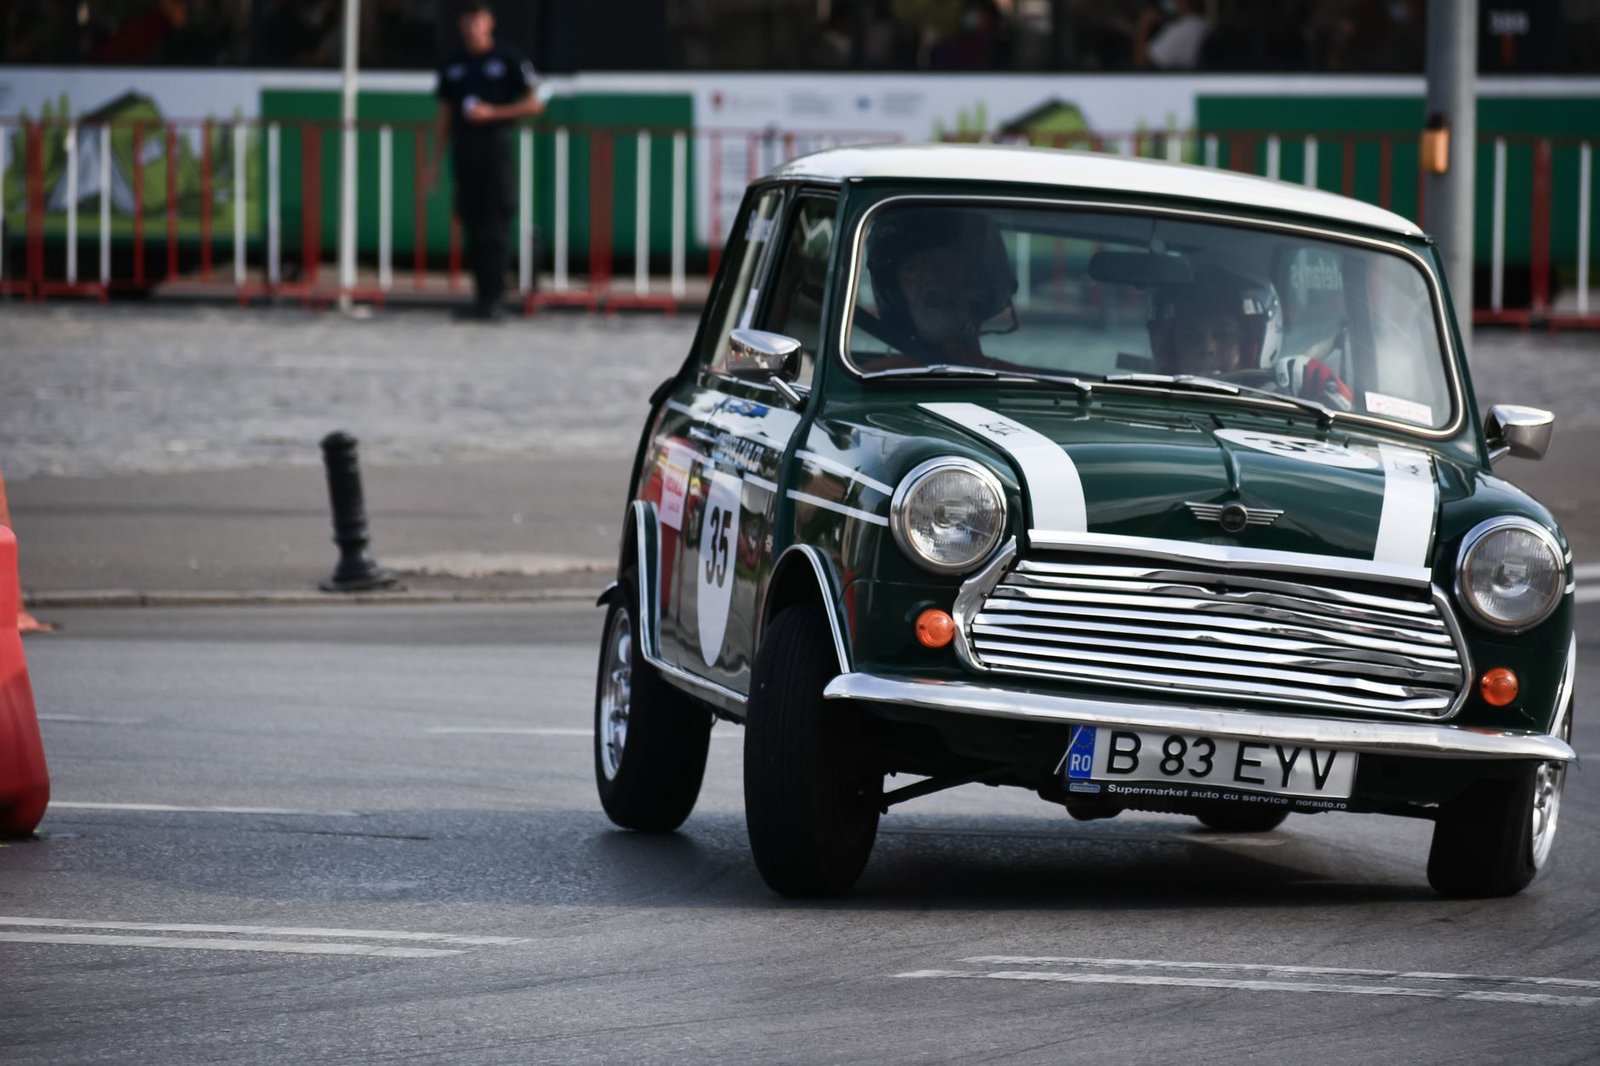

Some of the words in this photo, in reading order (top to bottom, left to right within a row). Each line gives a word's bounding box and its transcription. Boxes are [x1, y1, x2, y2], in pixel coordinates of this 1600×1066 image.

[706, 506, 732, 588] 35
[1070, 753, 1091, 773] RO
[1106, 730, 1142, 775] B
[1158, 734, 1217, 779] 83
[1233, 740, 1338, 791] EYV
[1107, 784, 1188, 797] Supermarket
[1191, 790, 1219, 799] auto
[1223, 793, 1239, 801] cu
[1242, 794, 1288, 805] service
[1295, 799, 1348, 809] norauto.ro
